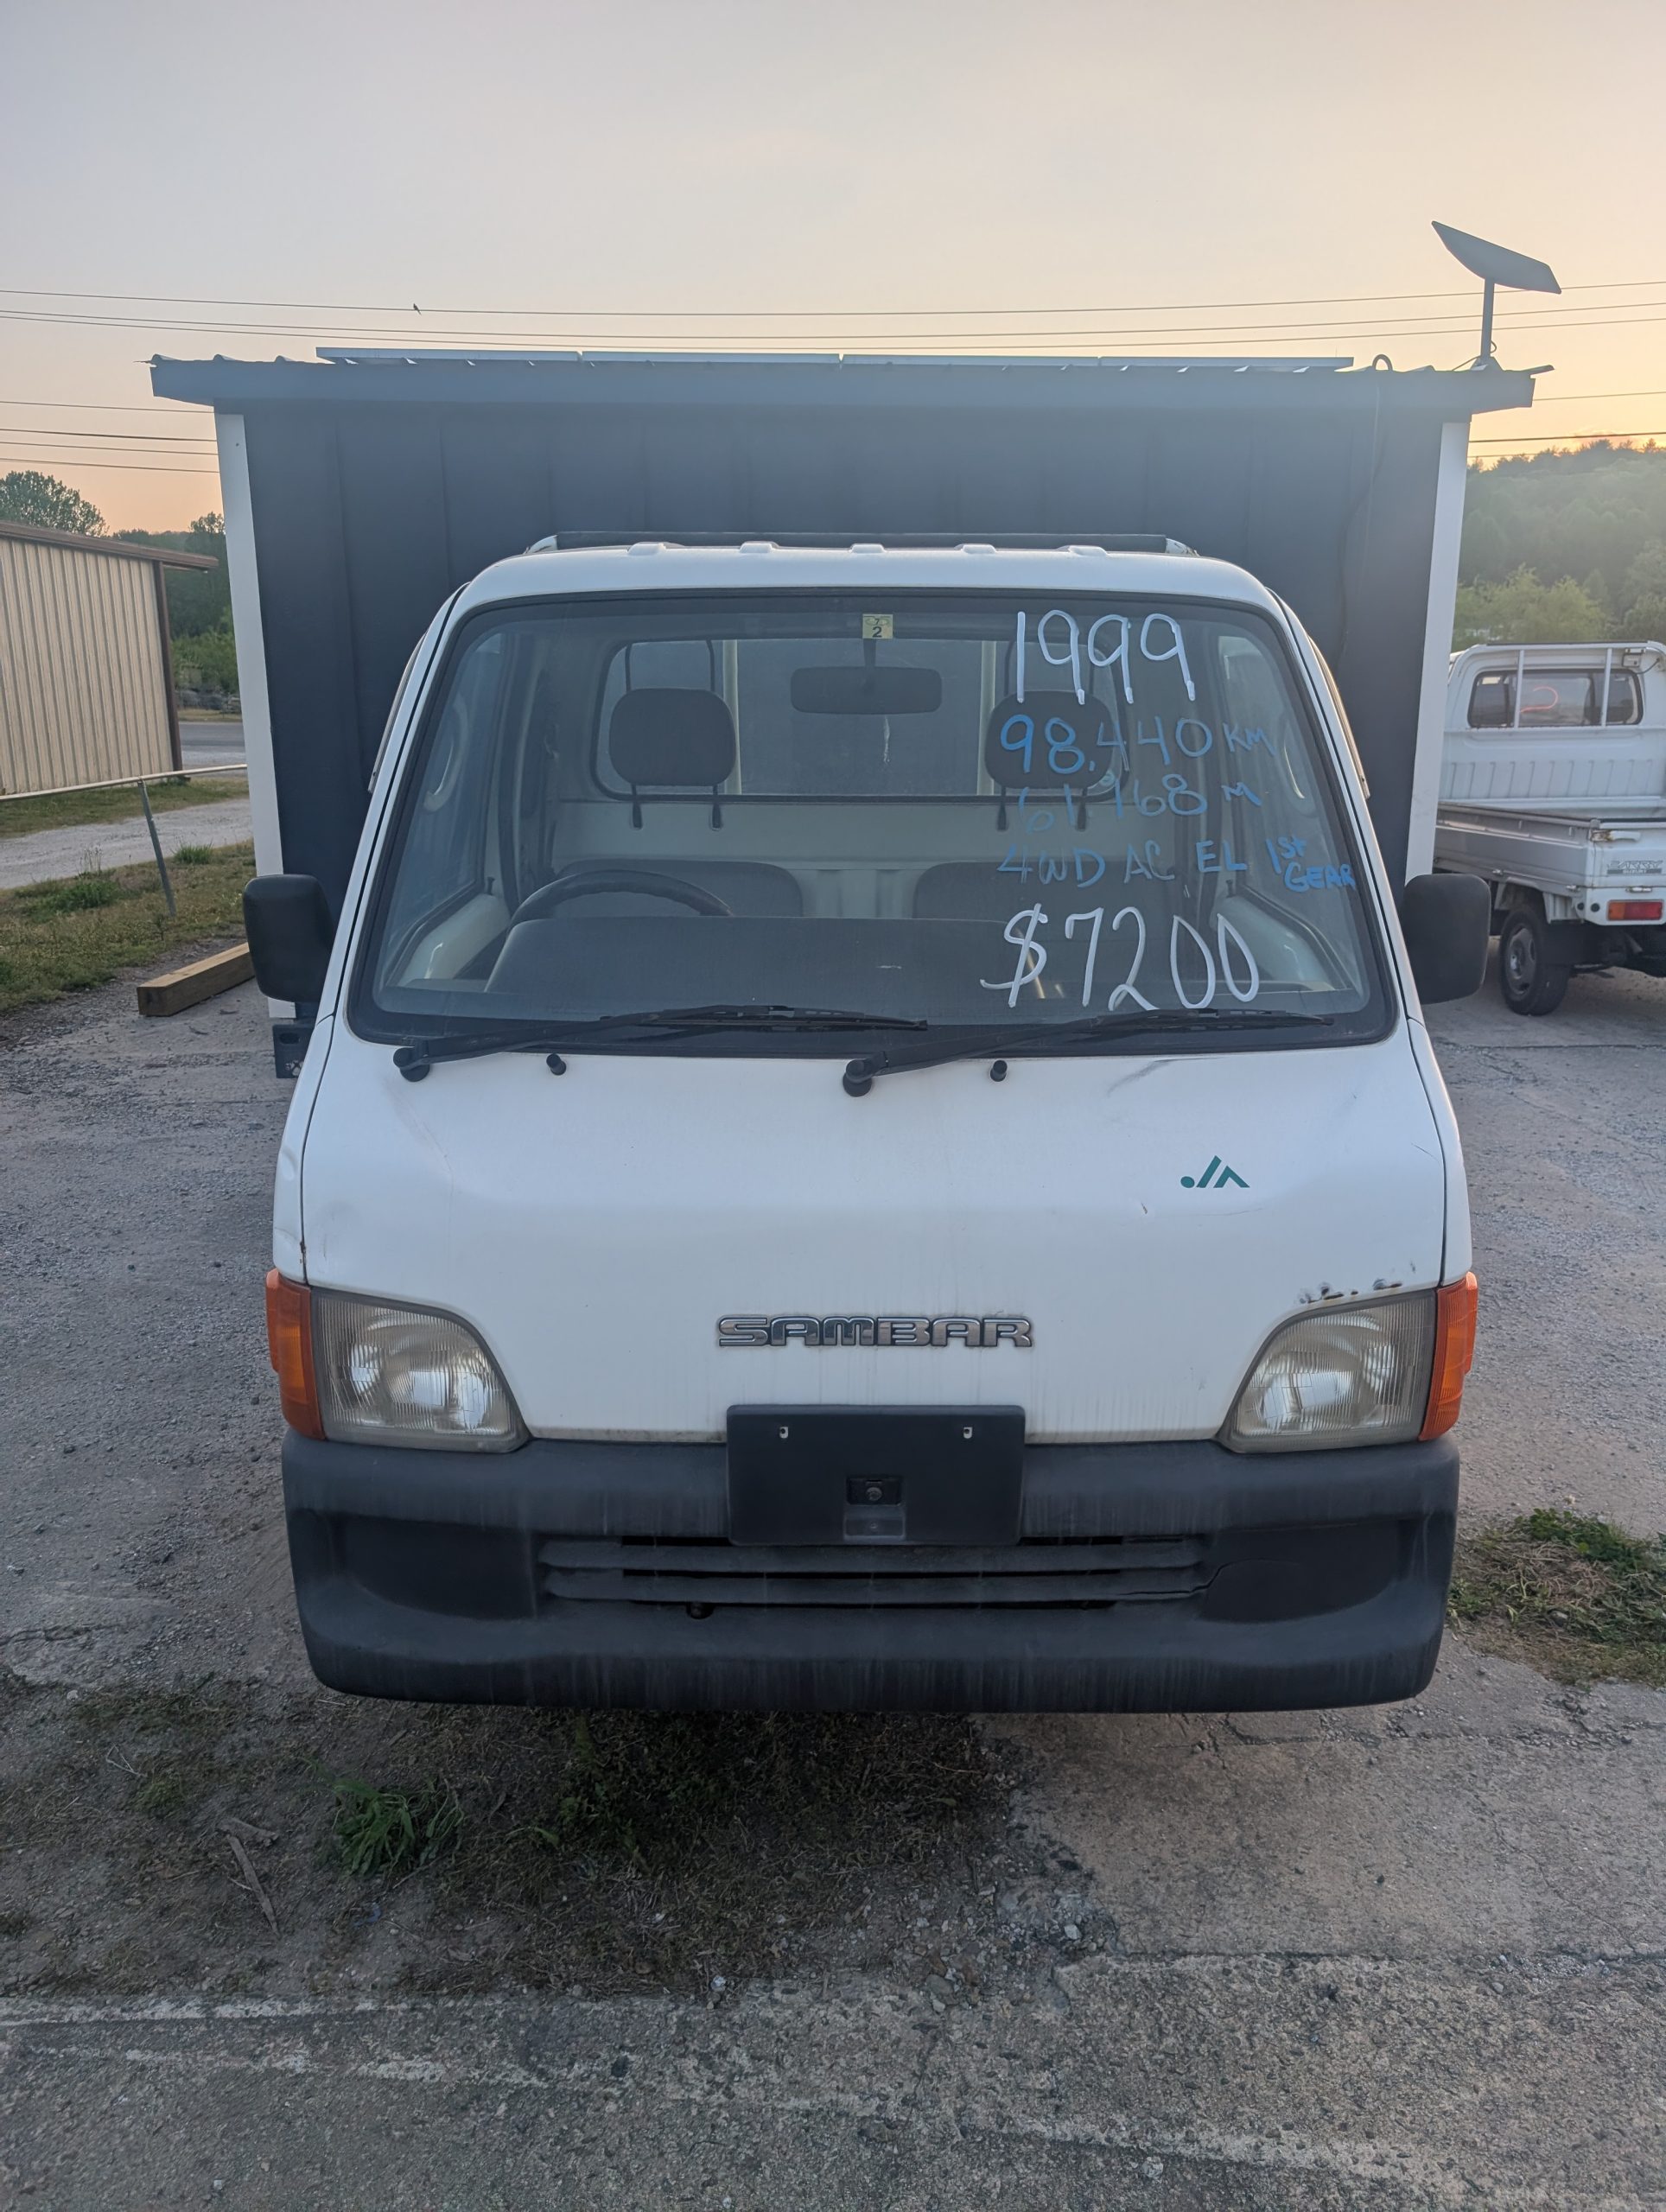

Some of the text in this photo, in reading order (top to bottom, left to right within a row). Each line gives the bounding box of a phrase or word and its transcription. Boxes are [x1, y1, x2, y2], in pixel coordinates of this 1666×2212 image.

[872, 626, 883, 638] 2
[1016, 609, 1196, 705] 1999
[1124, 840, 1175, 885] AC
[1196, 841, 1248, 873] EL
[1284, 861, 1358, 893] GEAR
[979, 903, 1261, 1012] $7200
[717, 1315, 1033, 1349] SAMBAR
